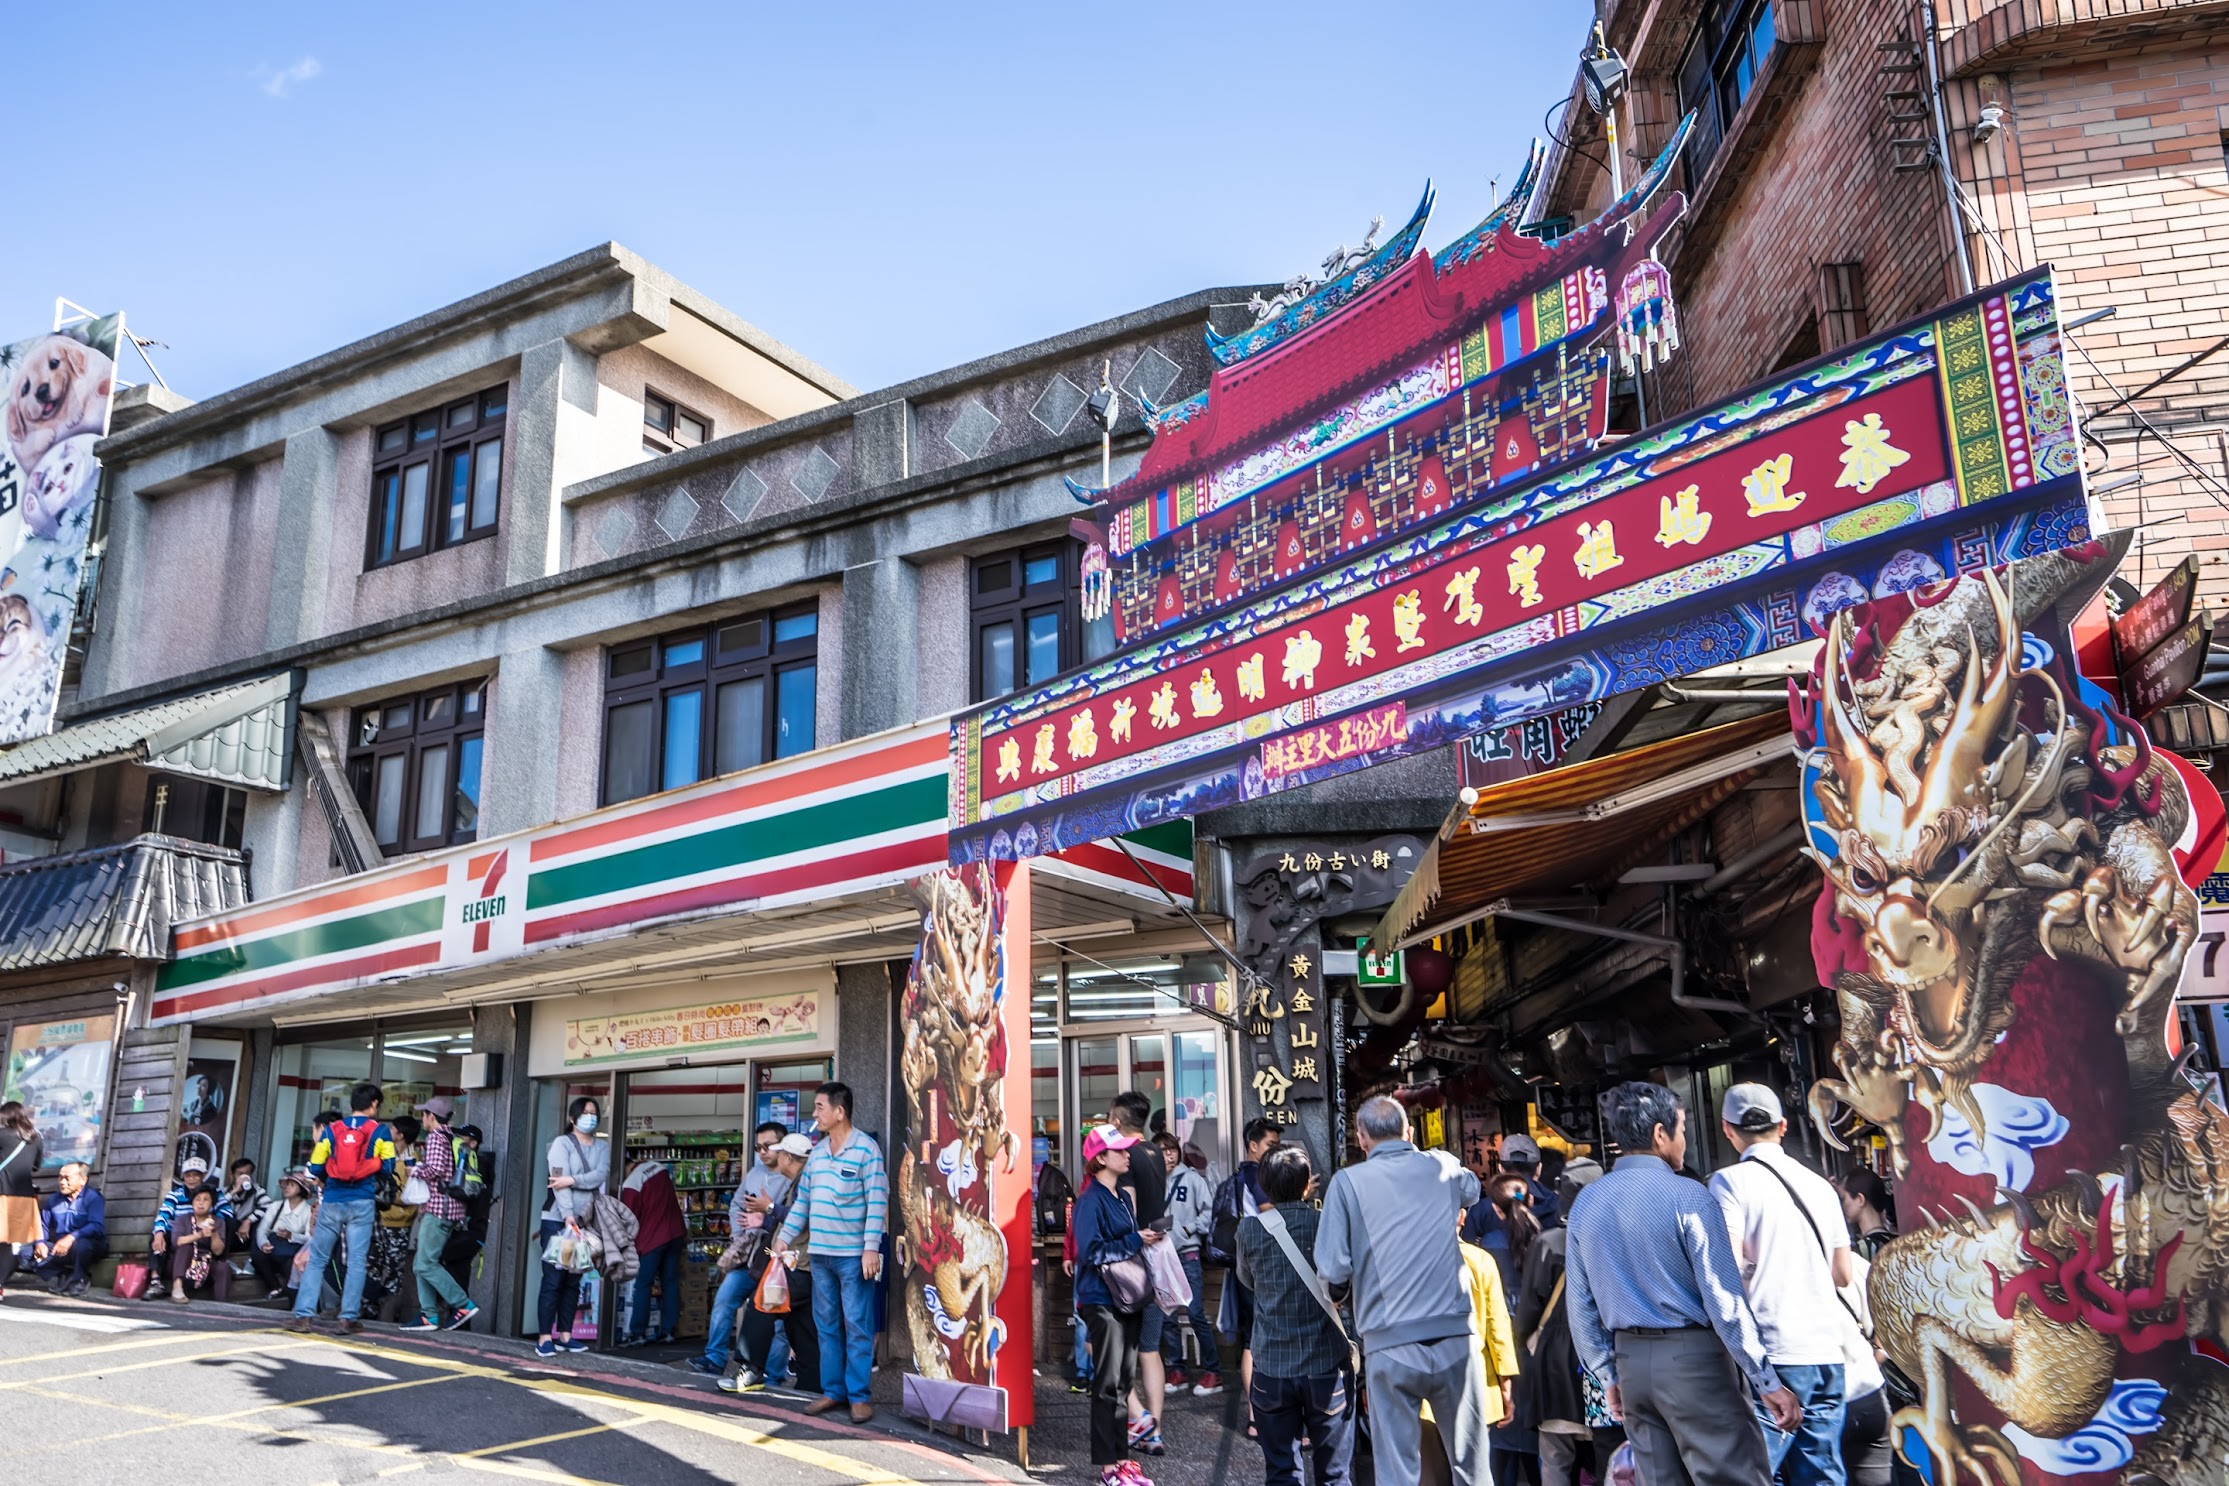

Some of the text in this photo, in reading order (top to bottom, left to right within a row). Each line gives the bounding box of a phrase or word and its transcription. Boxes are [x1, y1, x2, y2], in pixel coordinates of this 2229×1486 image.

[2163, 638, 2187, 665] Pavilion
[1278, 849, 1391, 874] 九份古い街
[1249, 1021, 1271, 1036] JIU
[1265, 1110, 1298, 1125] FEN
[1176, 1185, 1188, 1203] B
